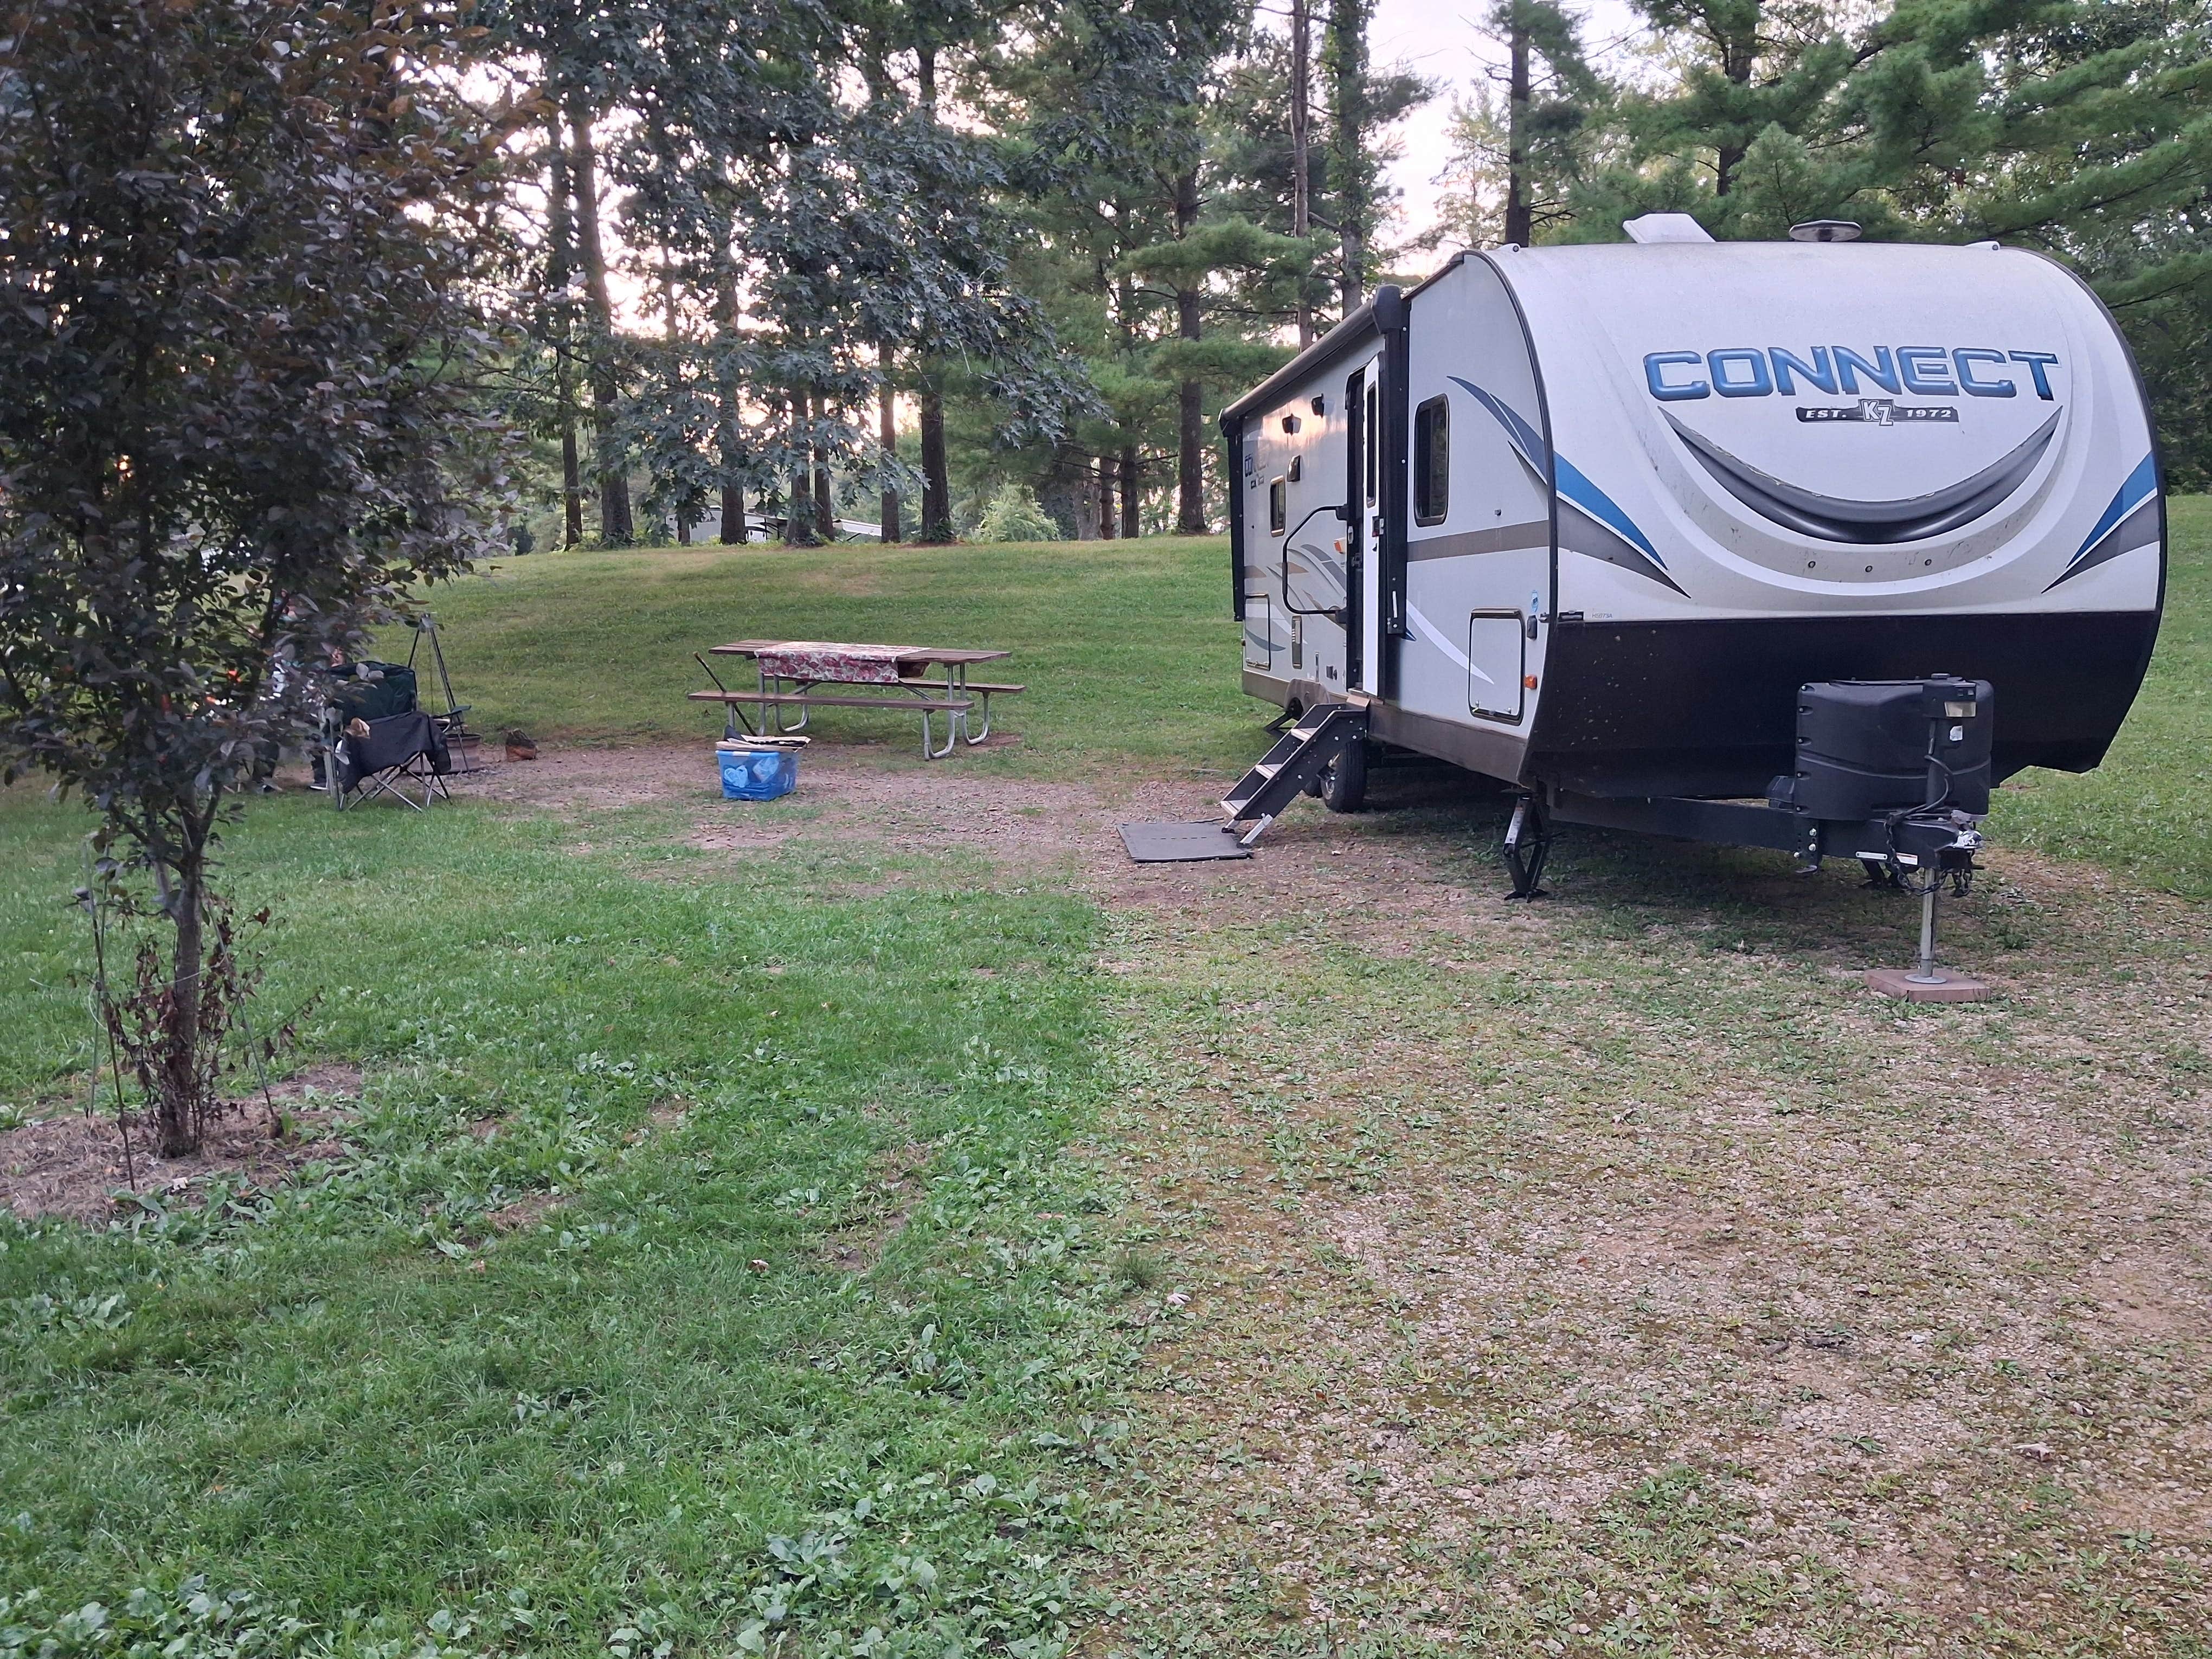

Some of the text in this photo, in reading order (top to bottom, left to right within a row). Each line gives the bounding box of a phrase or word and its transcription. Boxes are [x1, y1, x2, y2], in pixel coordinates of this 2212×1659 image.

[1644, 346, 2059, 401] CONNECT
[1805, 401, 1952, 426] EST. KZ 1972
